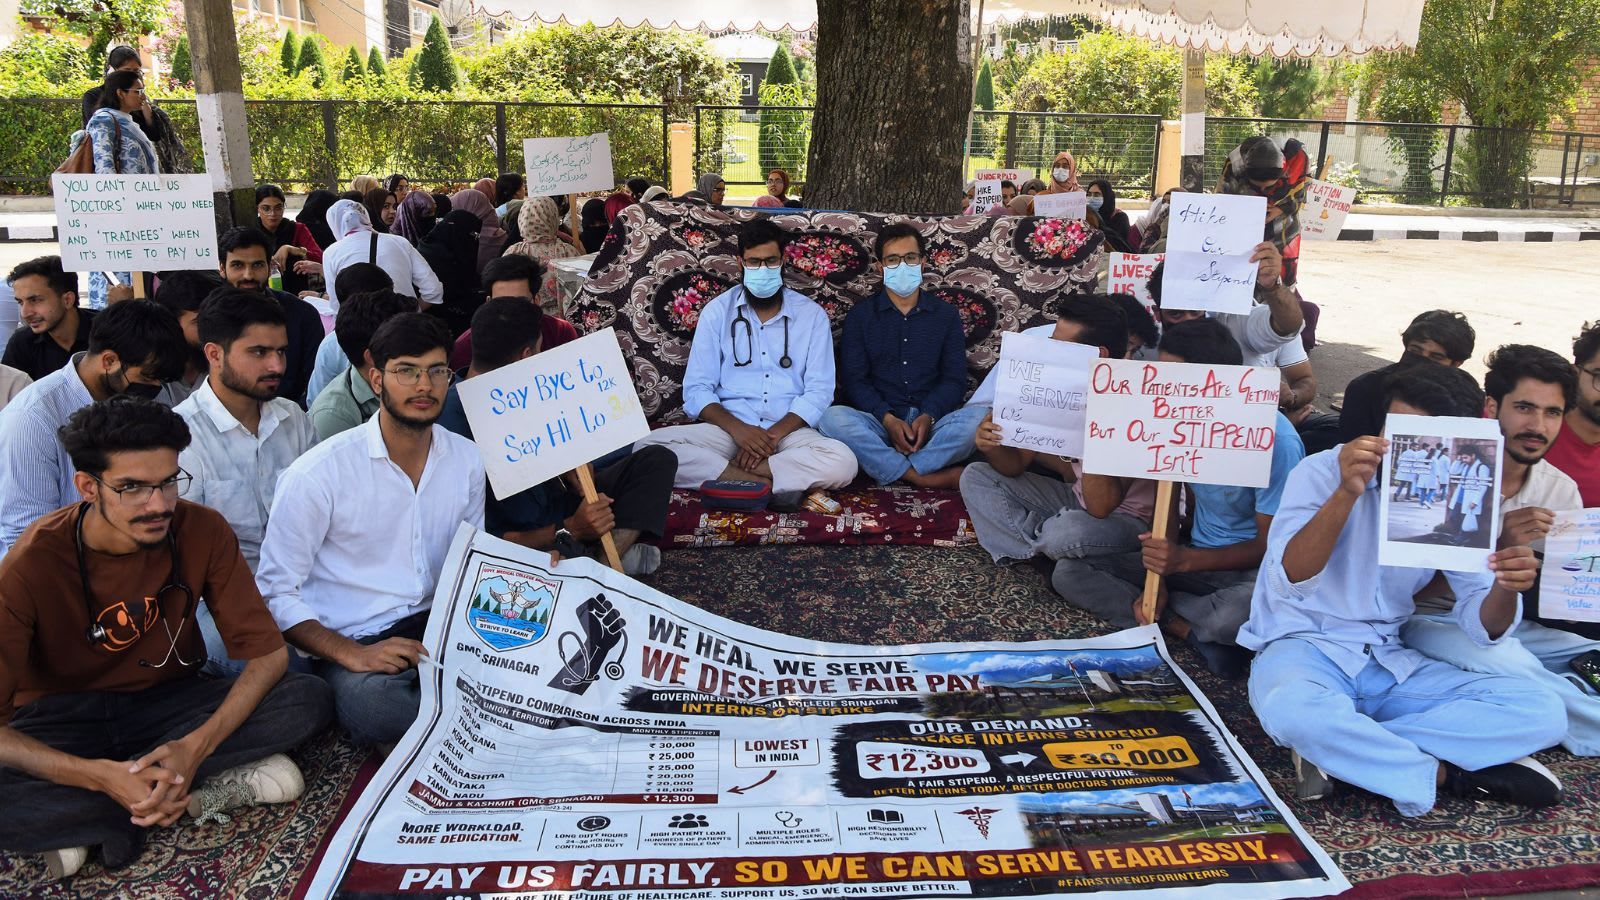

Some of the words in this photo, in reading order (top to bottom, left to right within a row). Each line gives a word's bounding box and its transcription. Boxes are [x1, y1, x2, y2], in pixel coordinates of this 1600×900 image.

[977, 172, 1018, 181] UNDERPAID
[62, 180, 89, 196] YOU
[96, 179, 125, 192] CAN'T
[134, 181, 160, 192] CALL
[167, 180, 179, 190] US
[977, 186, 992, 195] HIKE
[1307, 183, 1342, 199] FLATION
[65, 197, 126, 213] 'DOCTORS'
[136, 202, 162, 211] WHEN
[169, 201, 186, 211] YOU
[192, 200, 213, 209] NEED
[975, 206, 986, 214] BY
[1180, 203, 1228, 225] Hike
[1323, 198, 1351, 212] STIPEND
[67, 235, 88, 245] AND
[97, 228, 163, 243] 'TRAINEES'
[172, 230, 200, 239] WHEN
[1202, 236, 1228, 256] Our
[79, 250, 97, 260] IT'S
[106, 250, 132, 260] TIME
[144, 248, 157, 258] TO
[168, 247, 187, 260] PAY
[196, 248, 210, 257] US
[1113, 264, 1153, 279] LIVES
[1195, 260, 1254, 291] Stipend
[1009, 358, 1044, 382] WE
[490, 386, 528, 415] Say
[534, 369, 575, 401] Bye
[577, 358, 603, 384] to
[597, 377, 617, 392] 12K
[1142, 364, 1200, 396] PATIENTS
[1020, 385, 1087, 411] SERVE
[1153, 397, 1214, 418] BETTER
[504, 434, 541, 463] Say
[546, 411, 572, 447] Hi
[579, 406, 606, 434] to
[1011, 427, 1066, 448] Deserve
[1169, 421, 1275, 451] STIPPEND
[1147, 444, 1203, 475] Isn't
[479, 623, 500, 632] STRIVE
[510, 628, 529, 638] LEARN
[649, 614, 689, 650] WE
[773, 659, 817, 677] WE
[827, 660, 918, 677] SERVE.
[456, 642, 481, 658] GMC
[481, 653, 540, 676] SRINAGAR
[641, 645, 690, 686] WE
[697, 663, 838, 699] DESERVE
[848, 676, 918, 692] FAIR
[477, 681, 524, 704] STIPEND
[526, 697, 600, 722] COMPARISON
[603, 716, 650, 726] ACROSS
[654, 719, 687, 728] INDIA
[652, 692, 731, 703] GOVERNMENT
[841, 698, 899, 707] SRINAGAR
[483, 702, 509, 715] UNION
[511, 711, 554, 726] TERRITORY
[681, 703, 767, 716] INTERNS
[772, 706, 800, 717] ON
[806, 706, 875, 716] STRIKE
[479, 712, 514, 731] BENGAL
[909, 722, 963, 735] OUR
[971, 716, 1092, 731] DEMAND:
[452, 728, 474, 754] KERALA
[744, 739, 809, 752] LOWEST
[983, 730, 1071, 745] INTERNS
[1073, 727, 1159, 740] STIPEND
[443, 739, 464, 760] DELHI
[658, 752, 695, 761] 25,000
[755, 754, 767, 762] IN
[770, 753, 800, 761] INDIA
[438, 750, 505, 780] MAHARASHTRA
[865, 753, 978, 774] ₹12,300
[432, 762, 486, 790] KARNATAKA
[873, 788, 916, 796] BETTER
[919, 787, 968, 795] INTERNS
[970, 785, 1009, 794] TODAY.
[1012, 783, 1053, 792] BETTER
[1056, 780, 1109, 790] DOCTORS
[1111, 775, 1178, 787] TOMORROW.
[907, 780, 916, 788] A
[919, 779, 945, 788] FAIR
[949, 776, 1001, 786] STIPEND.
[1017, 770, 1089, 784] RESPECTFUL
[1092, 769, 1139, 779] FUTURE.
[427, 774, 450, 798] TAMIL
[419, 788, 453, 808] JAMMU
[467, 800, 515, 808] KASHMIR
[518, 798, 545, 806] (GMC
[548, 795, 605, 804] SRINAGAR)
[654, 795, 695, 803] 12,300
[401, 821, 441, 834] MORE
[445, 821, 525, 833] WORKLOAD.
[397, 834, 441, 845] SAME
[440, 832, 523, 844] DEDICATION.
[399, 867, 486, 890] PAY
[497, 865, 556, 888] US
[570, 862, 721, 887] FAIRLY,
[735, 861, 788, 883] SO
[802, 856, 868, 881] WE
[882, 854, 966, 878] CAN
[976, 850, 1082, 875] SERVE
[1089, 840, 1279, 870] FEARLESSLY.
[1057, 869, 1230, 887] #FAIRSTIPENDFORINTERNS
[637, 891, 717, 900] HEALTHCARE.
[721, 890, 774, 899] SUPPORT
[779, 889, 798, 898] US,
[823, 886, 840, 895] WE
[844, 886, 868, 894] CAN
[871, 885, 910, 893] SERVE
[912, 883, 960, 891] BETTER.
